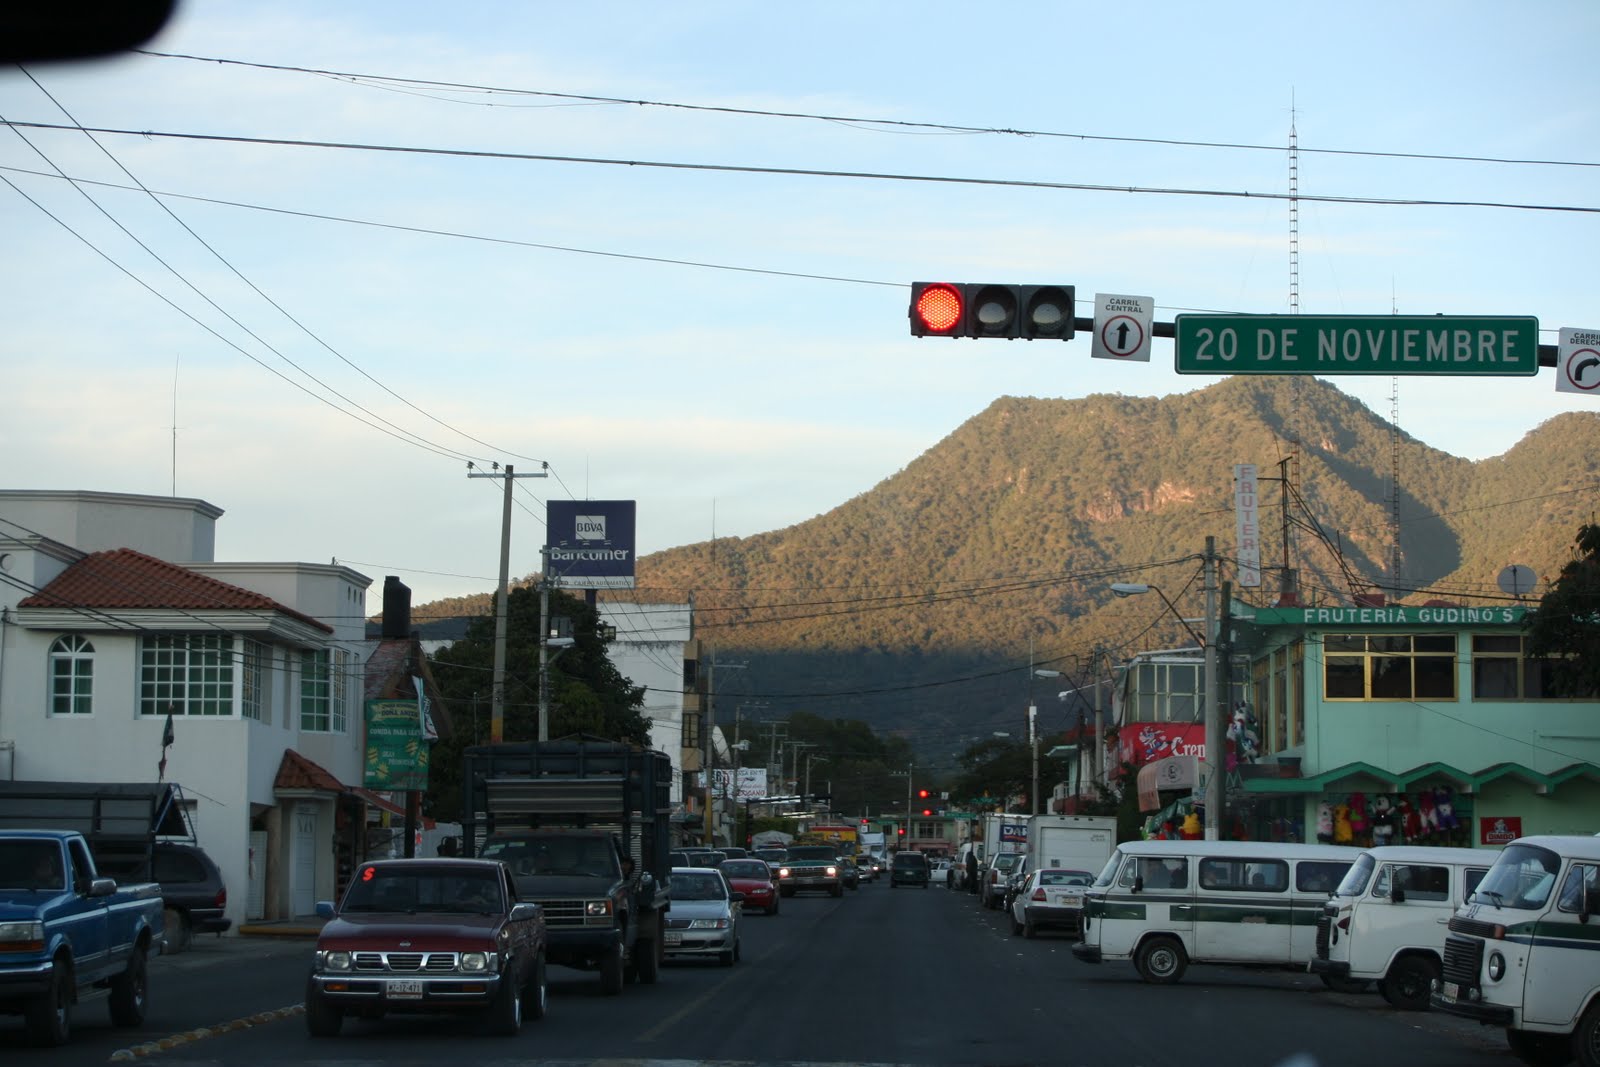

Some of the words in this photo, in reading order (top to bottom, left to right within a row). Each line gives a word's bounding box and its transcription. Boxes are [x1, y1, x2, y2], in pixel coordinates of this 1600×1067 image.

[1109, 298, 1140, 306] CARRIL
[1105, 304, 1143, 313] CENTRAL
[1574, 332, 1600, 340] CARRI
[1195, 328, 1238, 362] 20
[1256, 328, 1298, 362] DE
[1317, 329, 1520, 362] NOVIEMBRE
[576, 522, 604, 532] BBVA
